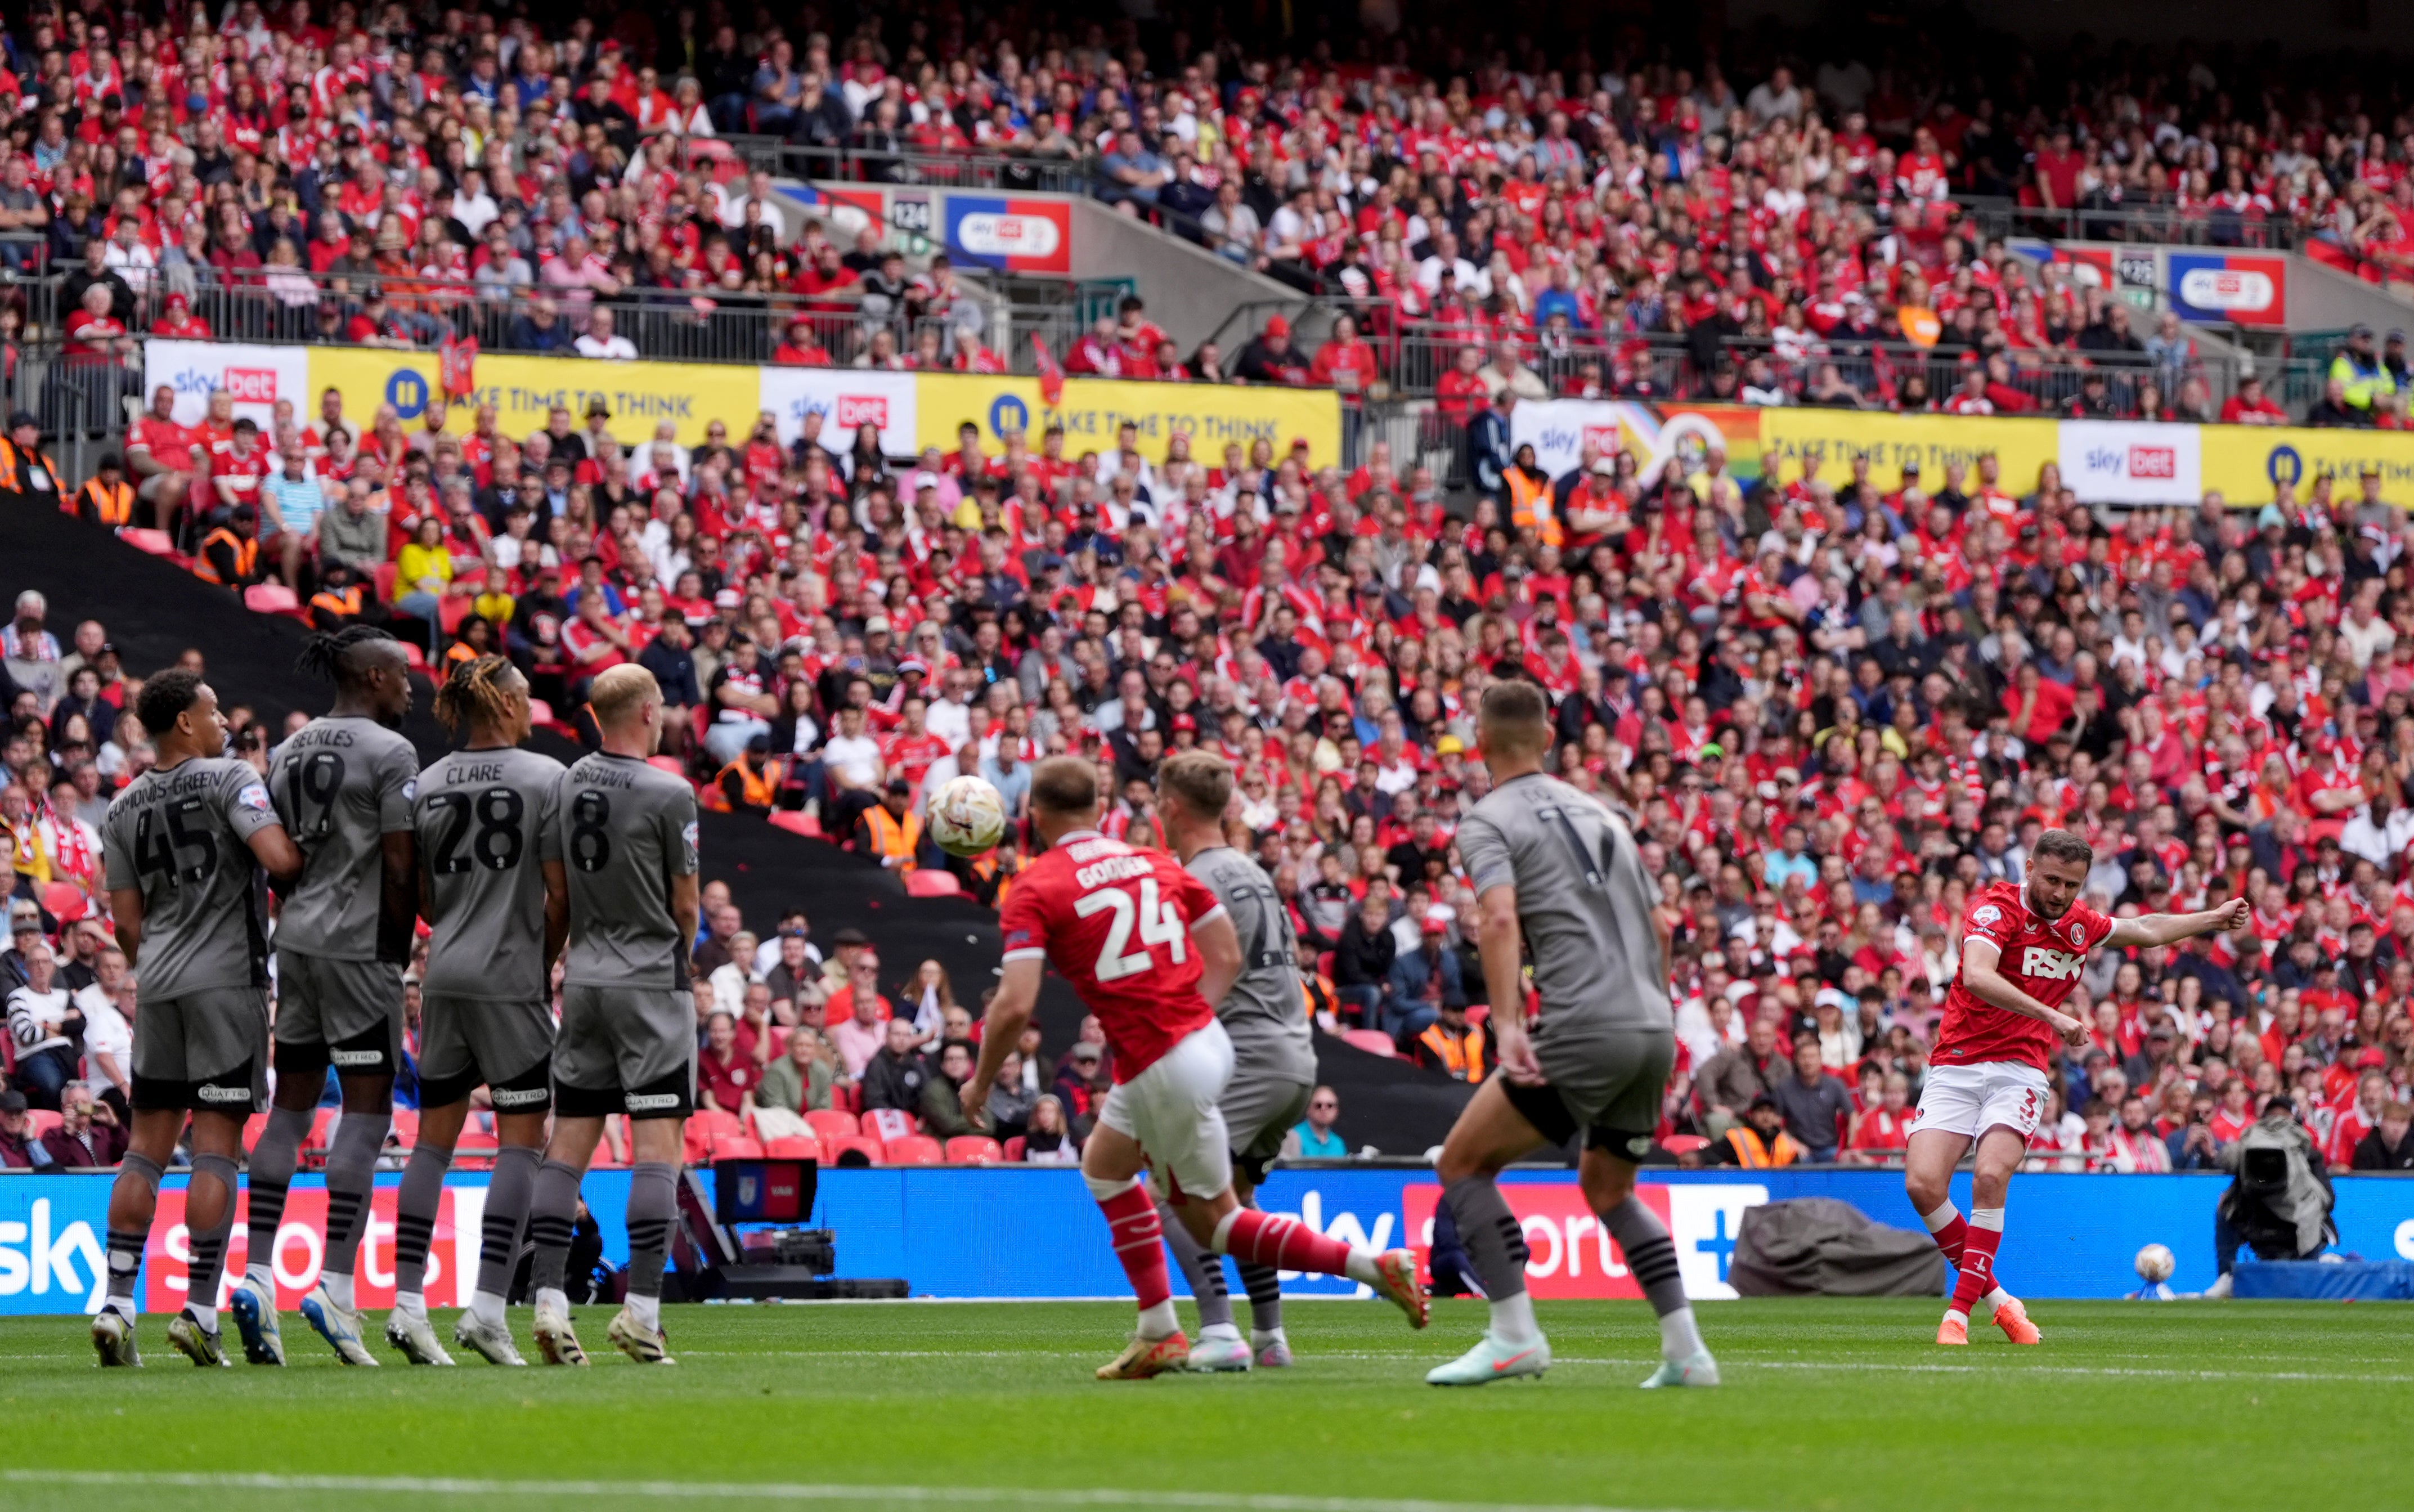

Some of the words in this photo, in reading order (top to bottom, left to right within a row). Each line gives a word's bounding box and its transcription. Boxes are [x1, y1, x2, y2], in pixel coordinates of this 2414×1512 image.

[895, 203, 927, 228] 124
[227, 369, 275, 400] bet
[444, 387, 501, 411] AKE
[614, 391, 694, 418] THINK
[841, 397, 885, 427] bet
[1205, 415, 1278, 441] THINK
[1540, 424, 1576, 455] sky
[2085, 444, 2124, 477] sky
[2131, 446, 2173, 475] bet
[2376, 459, 2414, 482] TIM
[291, 729, 355, 749] BECKLES
[447, 764, 504, 785] CLARE
[573, 765, 636, 788] BROWN
[285, 751, 346, 842] 19
[135, 795, 217, 887] 45
[427, 787, 524, 874] 28
[570, 789, 610, 872] 8
[1076, 855, 1154, 890] GODDEN
[1073, 878, 1186, 983] 24
[2022, 946, 2087, 981] RSK
[0, 1197, 107, 1314] sky
